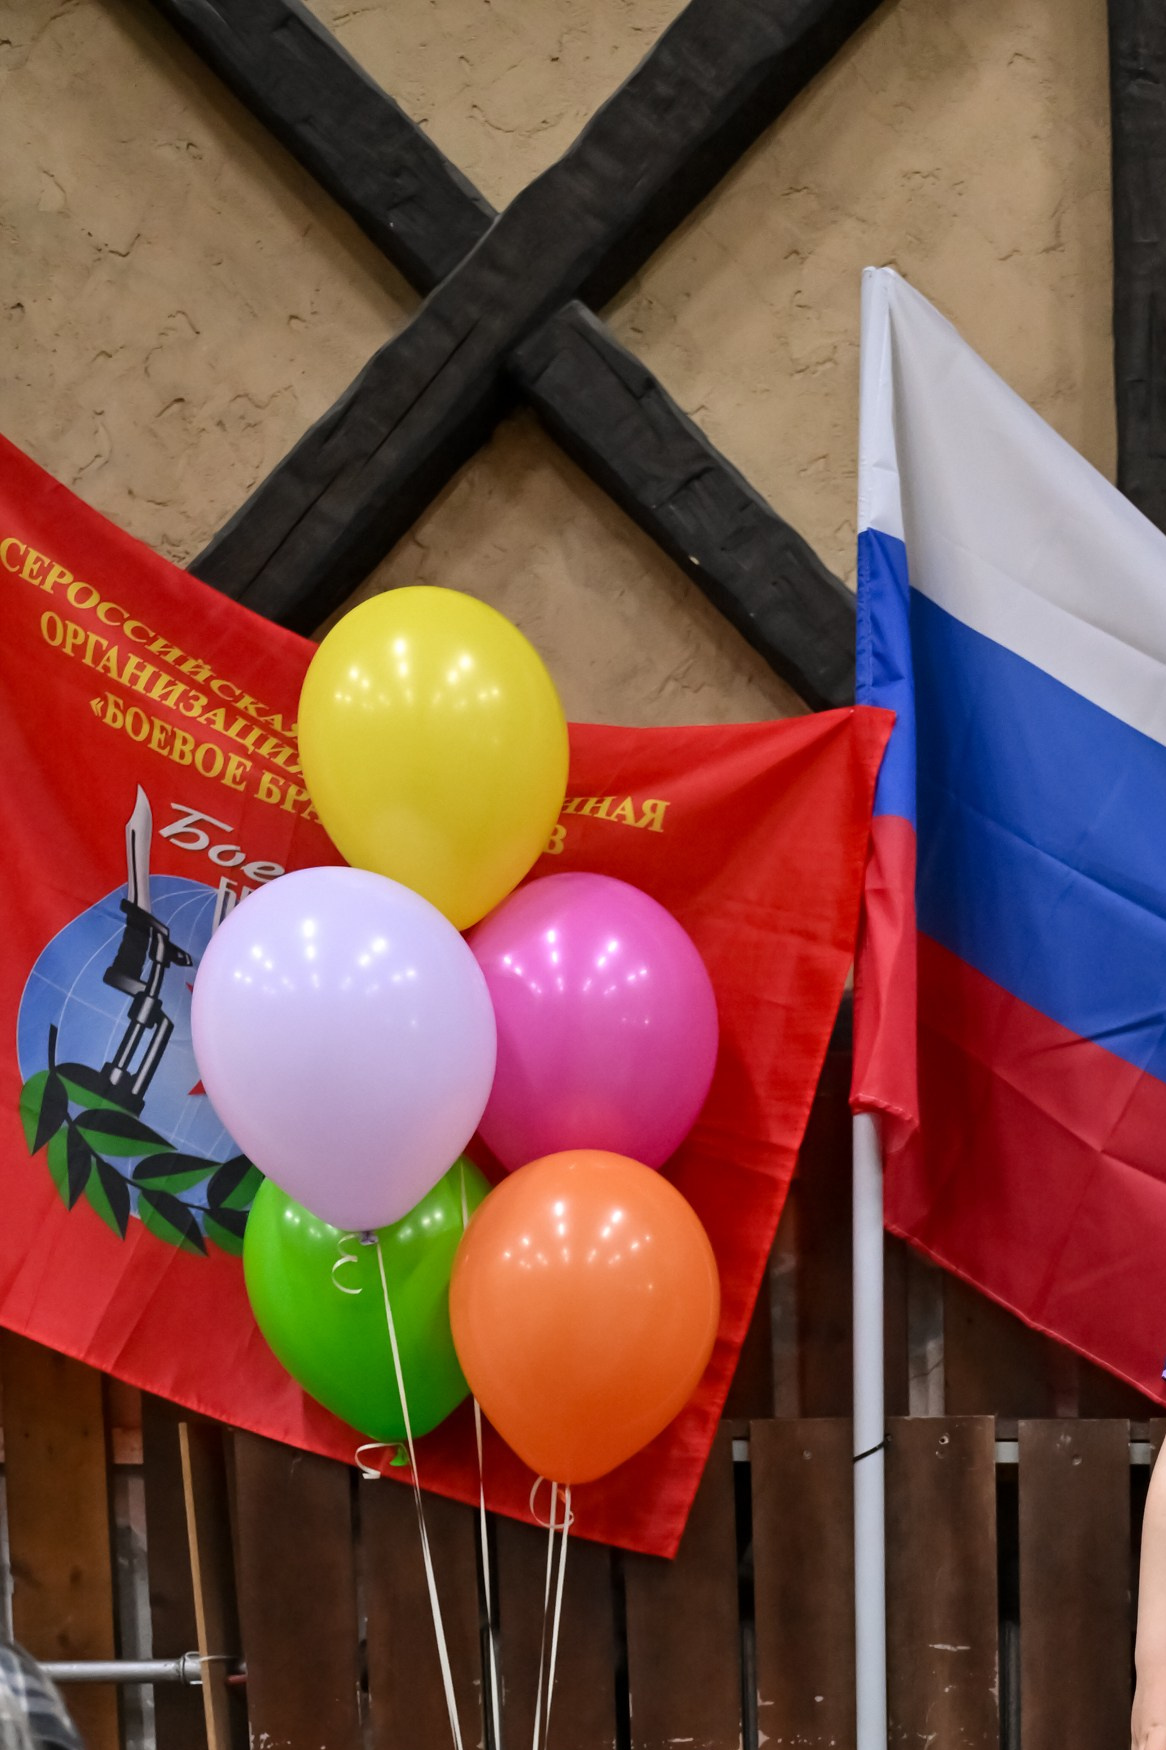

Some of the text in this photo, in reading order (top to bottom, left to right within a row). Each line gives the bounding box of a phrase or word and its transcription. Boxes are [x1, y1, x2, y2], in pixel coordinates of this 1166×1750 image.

[0, 537, 671, 833] СЕРОССИЙСКА ННАЯ
[90, 692, 252, 791] «БОЕВОЕ
[158, 802, 285, 884] Бое
